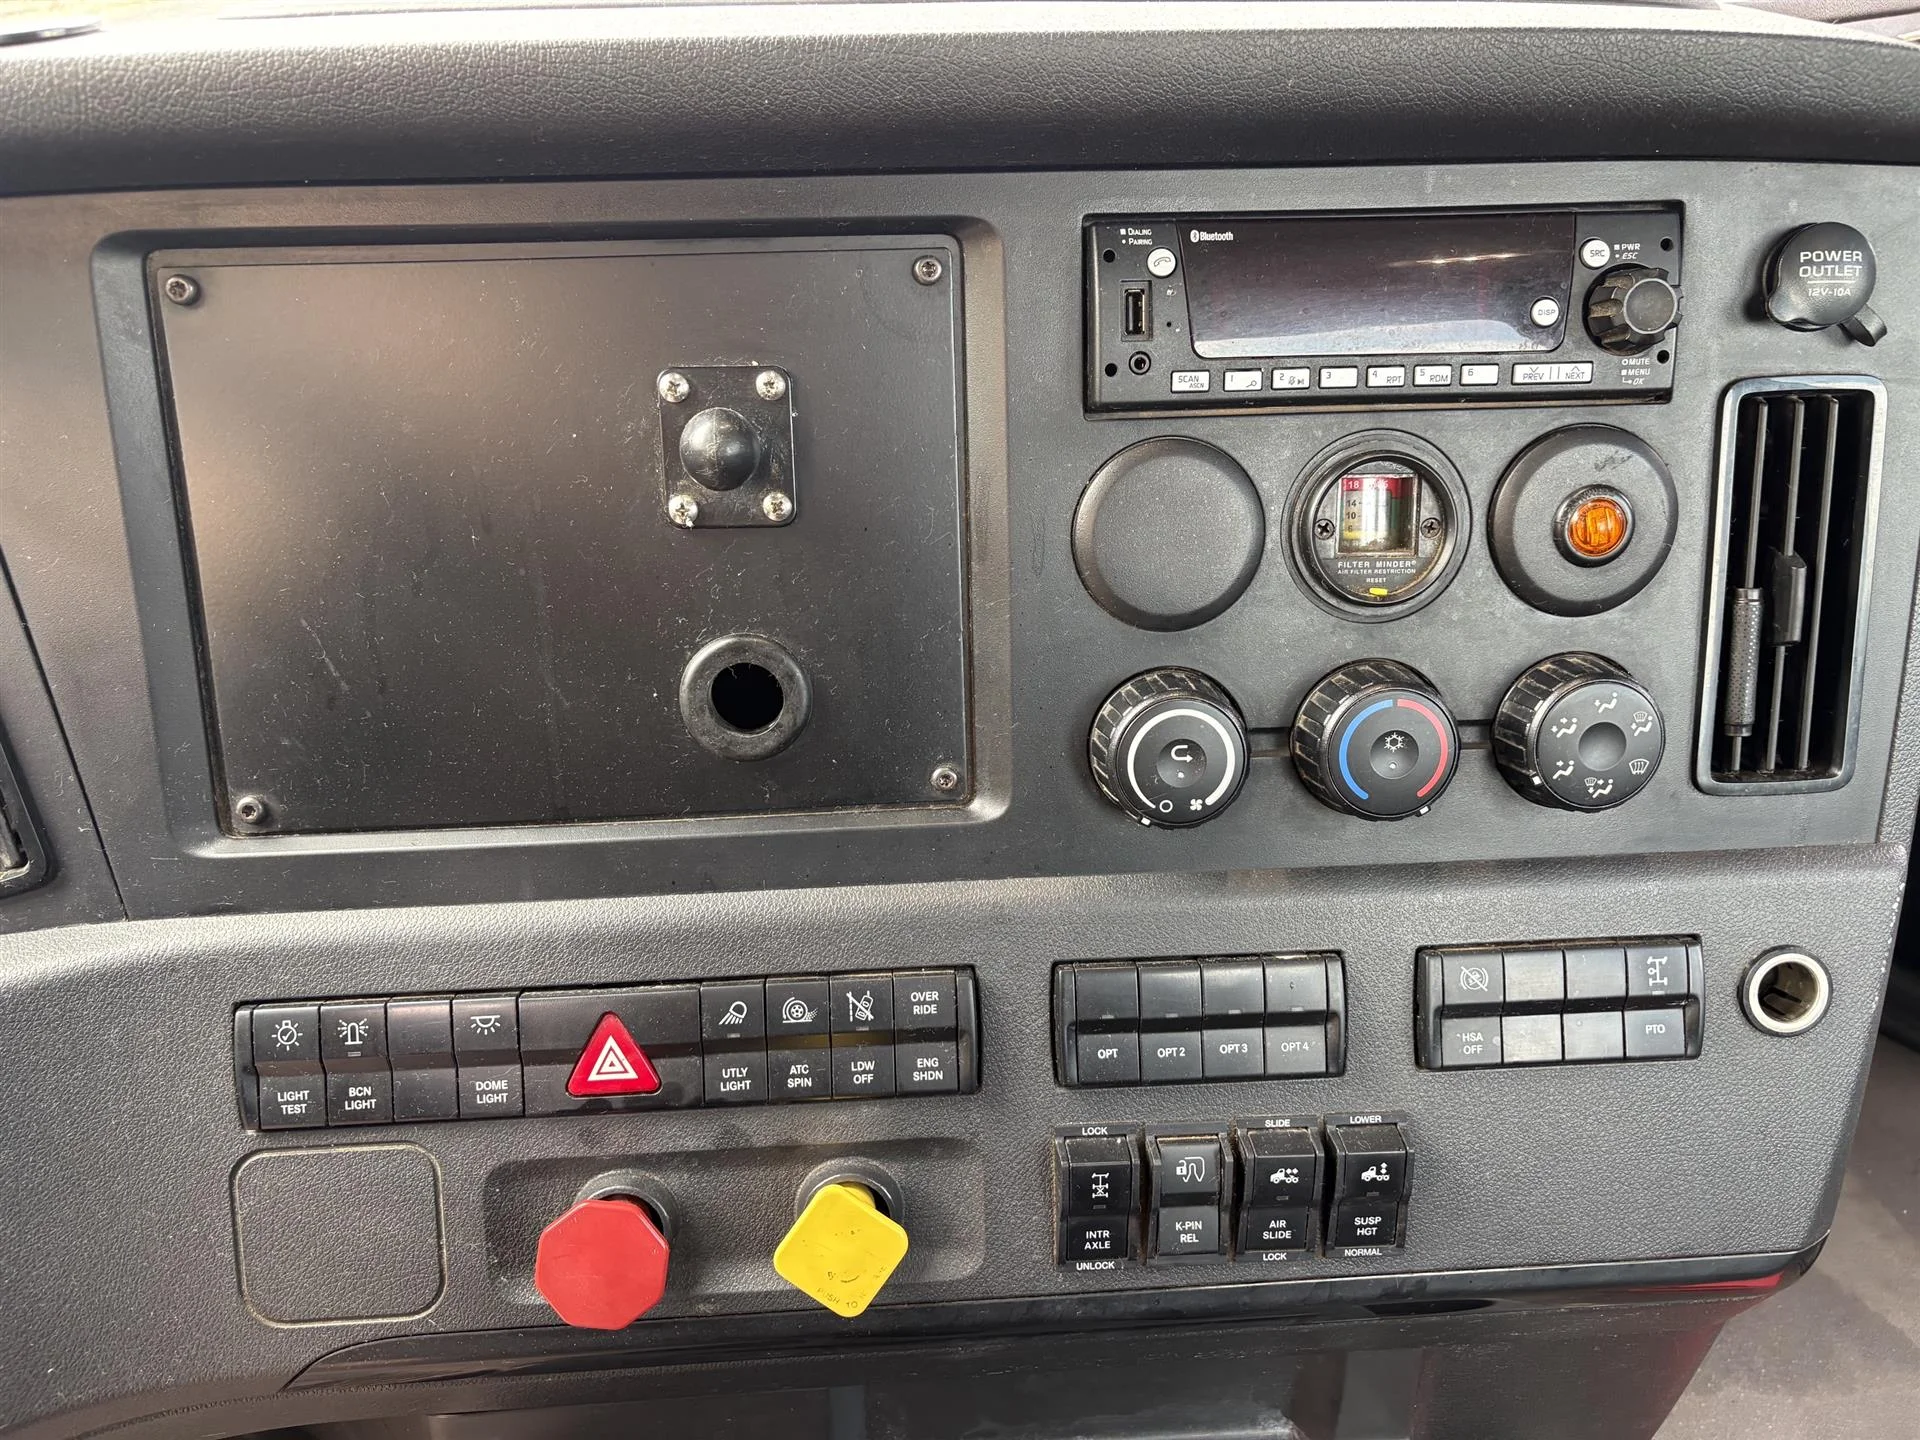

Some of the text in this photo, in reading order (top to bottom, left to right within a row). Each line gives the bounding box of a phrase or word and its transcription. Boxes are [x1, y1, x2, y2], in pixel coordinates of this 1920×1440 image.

[1199, 231, 1234, 241] Bluetooth
[1621, 243, 1641, 251] PWR
[1590, 249, 1606, 258] SRC
[1622, 252, 1638, 260] ESC
[1799, 250, 1863, 263] POWER
[1799, 264, 1863, 278] OUTLET
[1808, 287, 1852, 297] 12V-10A
[1537, 308, 1557, 317] DISP
[1628, 357, 1650, 366] MUTE
[1279, 373, 1286, 381] 2
[1325, 371, 1332, 380] 3
[1371, 370, 1378, 378] 4
[1419, 368, 1426, 377] 5
[1467, 368, 1474, 377] 6
[1522, 371, 1545, 381] PREV
[1565, 371, 1586, 380] NEXT
[1627, 368, 1651, 377] MENU
[1177, 375, 1200, 384] SCAN
[1386, 376, 1403, 385] RPT
[1429, 374, 1449, 383] RDM
[1633, 377, 1644, 385] OK
[1349, 480, 1360, 489] 18
[1347, 500, 1357, 508] 14
[1346, 512, 1357, 520] 10
[1337, 561, 1371, 569] FILTER
[910, 991, 940, 1002] OVER
[912, 1004, 938, 1015] RIDE
[1645, 1023, 1666, 1035] PTO
[1462, 1032, 1484, 1043] HSA
[1219, 1042, 1248, 1054] OPT 3
[1281, 1041, 1310, 1052] OPT 4
[1463, 1044, 1483, 1055] OFF
[1097, 1048, 1119, 1060] OPT
[1157, 1046, 1186, 1058] OPT 2
[851, 1060, 875, 1072] LDW
[916, 1057, 939, 1069] ENG
[722, 1066, 748, 1079] UTLY
[789, 1064, 809, 1075] ATC
[853, 1073, 874, 1084] OFF
[912, 1069, 944, 1082] SHDN
[475, 1079, 508, 1091] DOME
[720, 1079, 751, 1092] LIGHT
[787, 1076, 812, 1088] SPIN
[277, 1090, 310, 1102] LIGHT
[348, 1086, 372, 1098] BCN
[476, 1092, 508, 1105] LIGHT
[280, 1103, 307, 1115] TEST
[344, 1098, 377, 1111] LIGHT
[1264, 1118, 1291, 1128] SLIDE
[1349, 1115, 1382, 1125] LOWER
[1082, 1126, 1108, 1136] LOCK
[1175, 1220, 1202, 1231] K-PIN
[1269, 1219, 1287, 1228] AIR
[1354, 1216, 1382, 1226] SUSP
[1085, 1230, 1110, 1239] INTR
[1262, 1230, 1292, 1240] SLIDE
[1356, 1227, 1378, 1236] HGT
[1180, 1233, 1199, 1243] REL
[1084, 1241, 1111, 1250] AXLE
[1262, 1252, 1287, 1261] LOCK
[1344, 1248, 1382, 1257] NORMAL
[1076, 1261, 1115, 1271] UNLOCK
